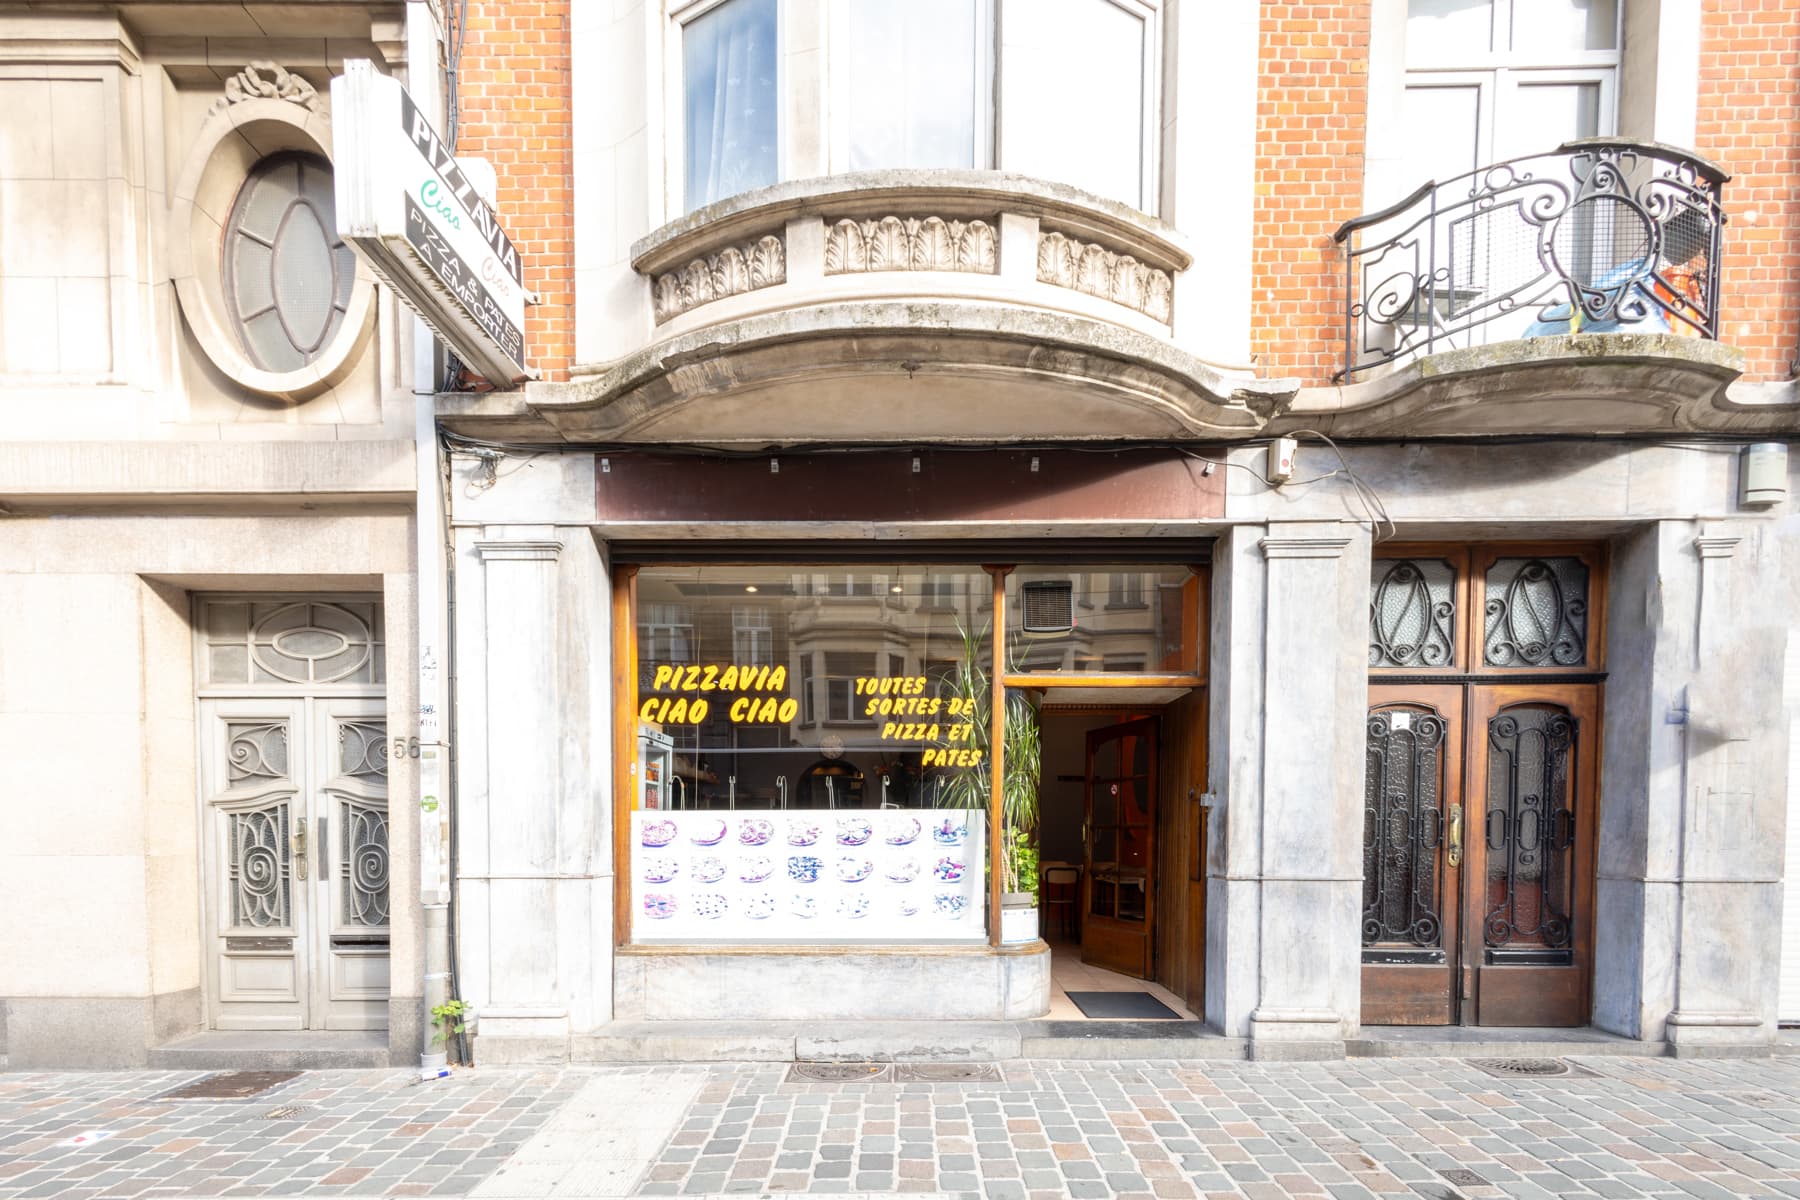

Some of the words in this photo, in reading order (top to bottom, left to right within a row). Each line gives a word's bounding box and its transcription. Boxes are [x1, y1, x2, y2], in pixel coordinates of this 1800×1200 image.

[411, 109, 517, 280] PIZZAVIA
[411, 208, 461, 276] PIZZA
[467, 278, 478, 296] &
[485, 296, 520, 346] PATES
[441, 263, 518, 359] EMPORTER
[653, 665, 786, 691] PIZZAVIA
[856, 677, 927, 695] TOUTES
[640, 698, 708, 724] CIAO
[730, 698, 798, 724] CIAO
[865, 698, 941, 715] SORTES
[948, 698, 974, 715] DE
[882, 723, 938, 741] PIZZA
[948, 723, 974, 741] ET
[394, 736, 421, 759] 56
[922, 749, 982, 767] PATES
